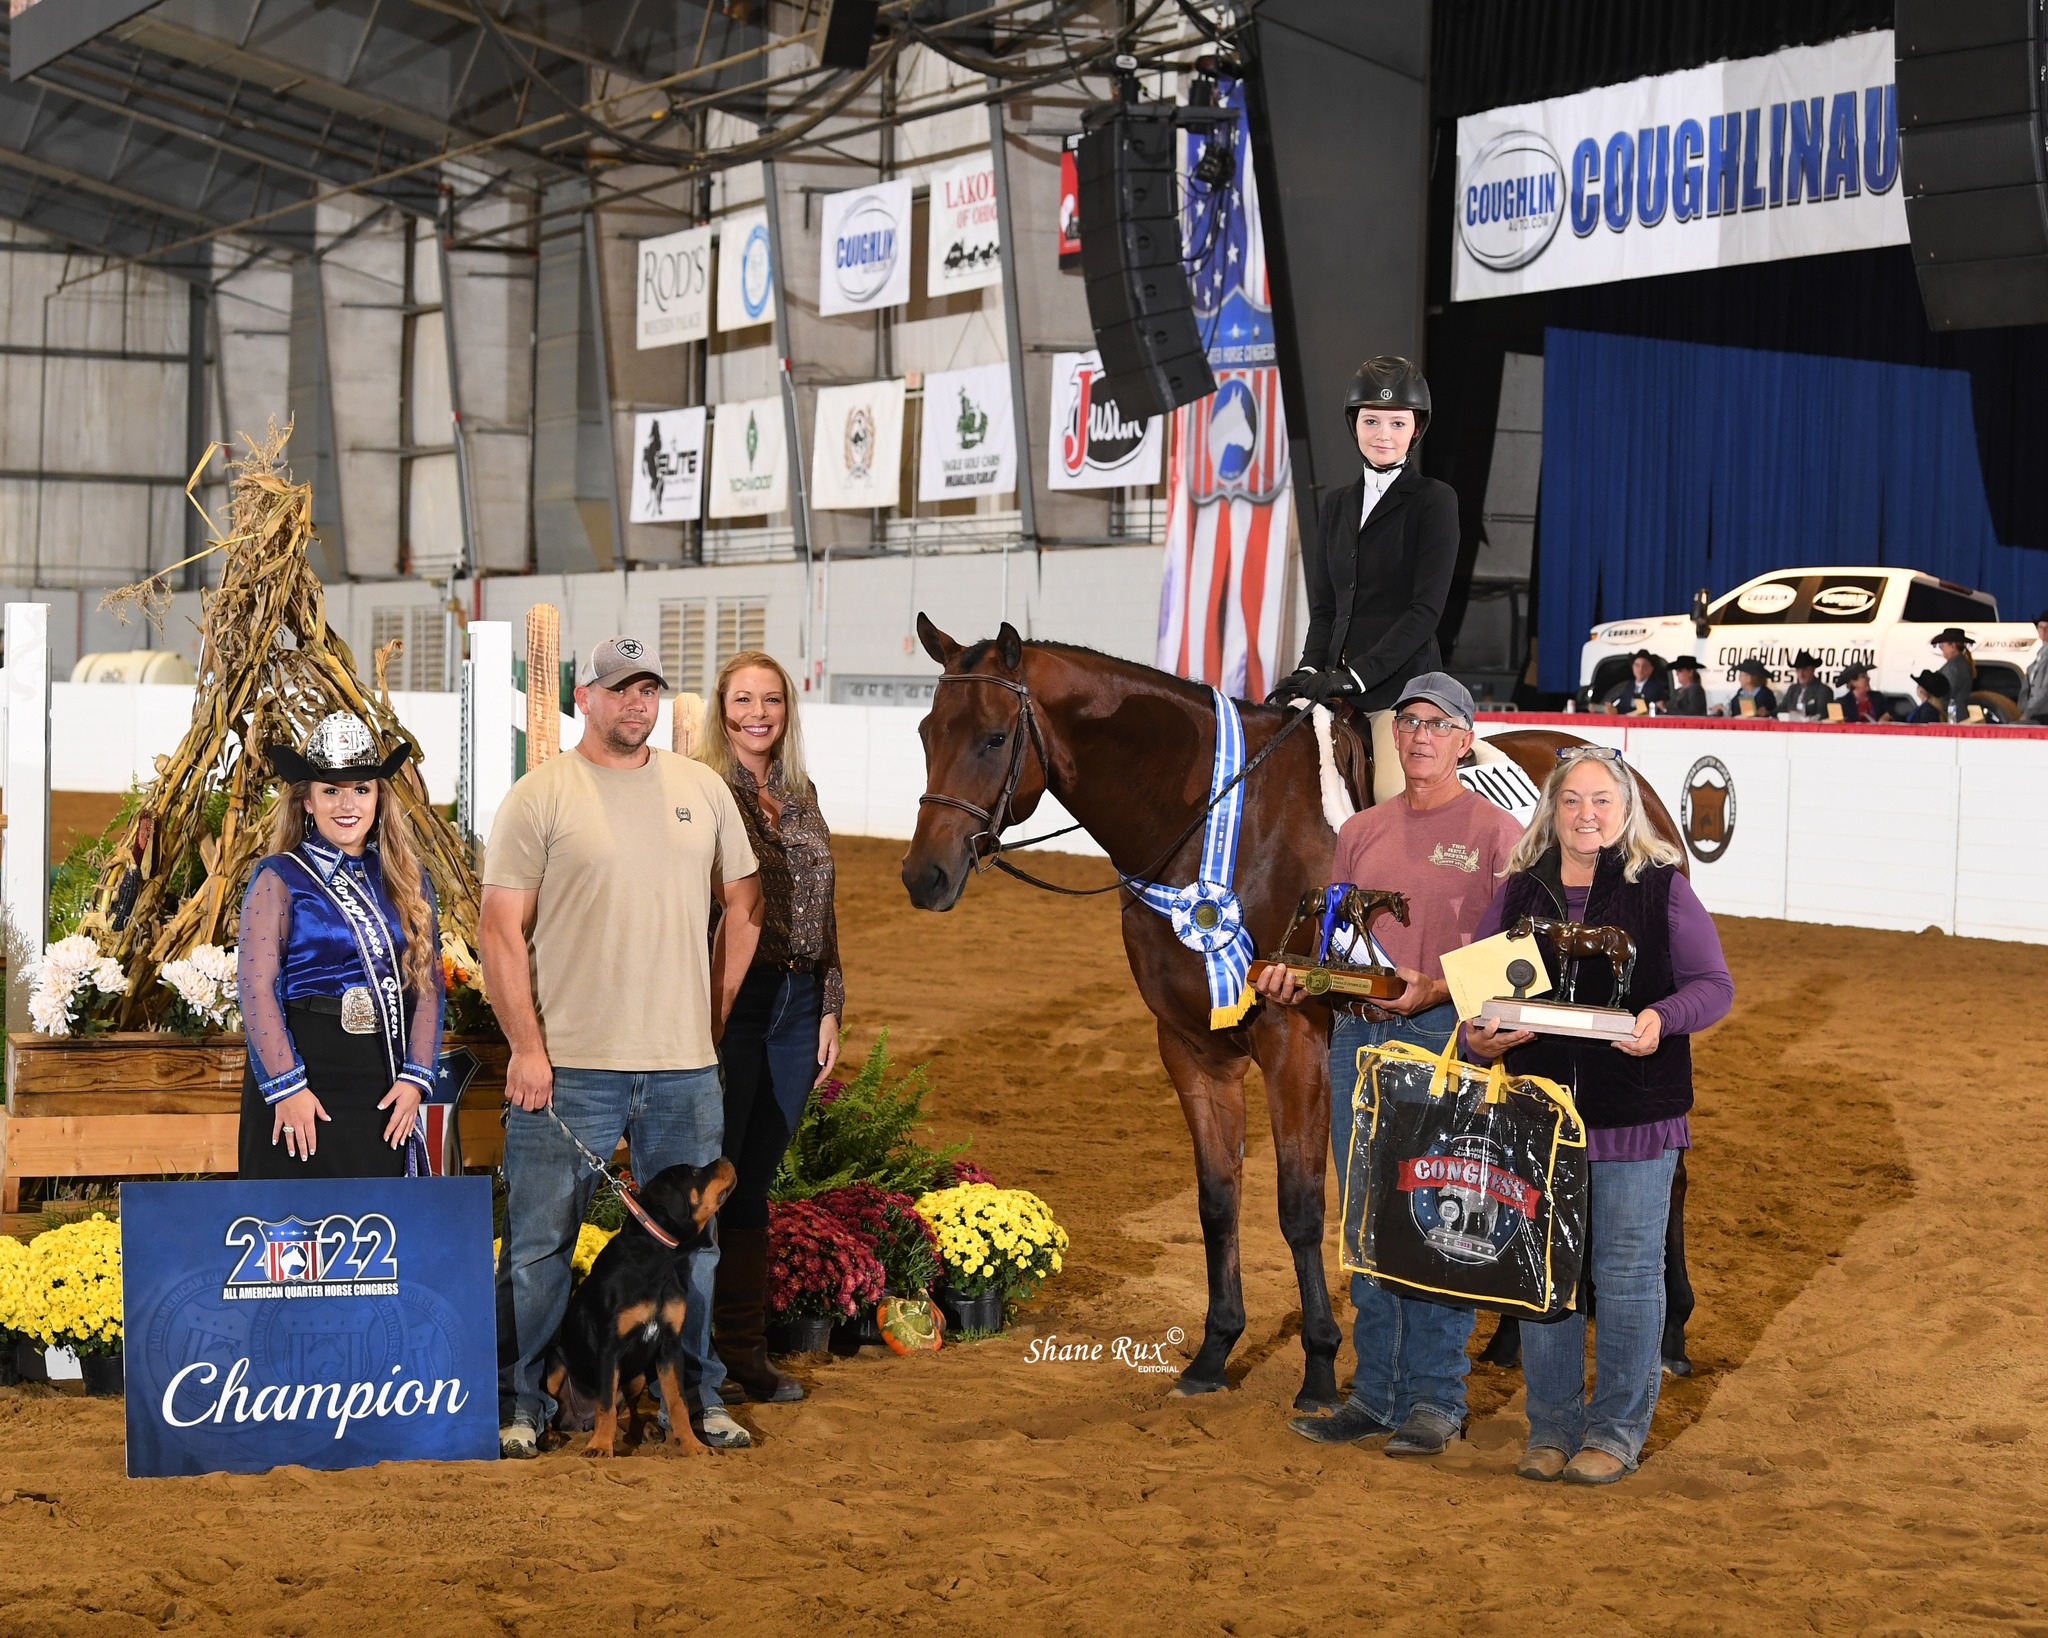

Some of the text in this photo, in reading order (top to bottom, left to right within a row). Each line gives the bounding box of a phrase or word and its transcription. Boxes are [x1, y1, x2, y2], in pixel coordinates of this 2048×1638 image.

[1465, 169, 1557, 228] COUGHLIN
[836, 228, 895, 269] COUGHLIN
[656, 450, 697, 475] ELITE
[1608, 628, 1647, 637] COUGHLIN
[331, 876, 384, 959] Congress
[381, 975, 399, 1040] Queen
[1470, 1147, 1499, 1160] AMECAN
[1414, 1159, 1526, 1202] CONGRESS
[222, 1282, 399, 1300] ALL AMERICAN QUARTER HORSE CONGRESS
[161, 1357, 469, 1440] Champion
